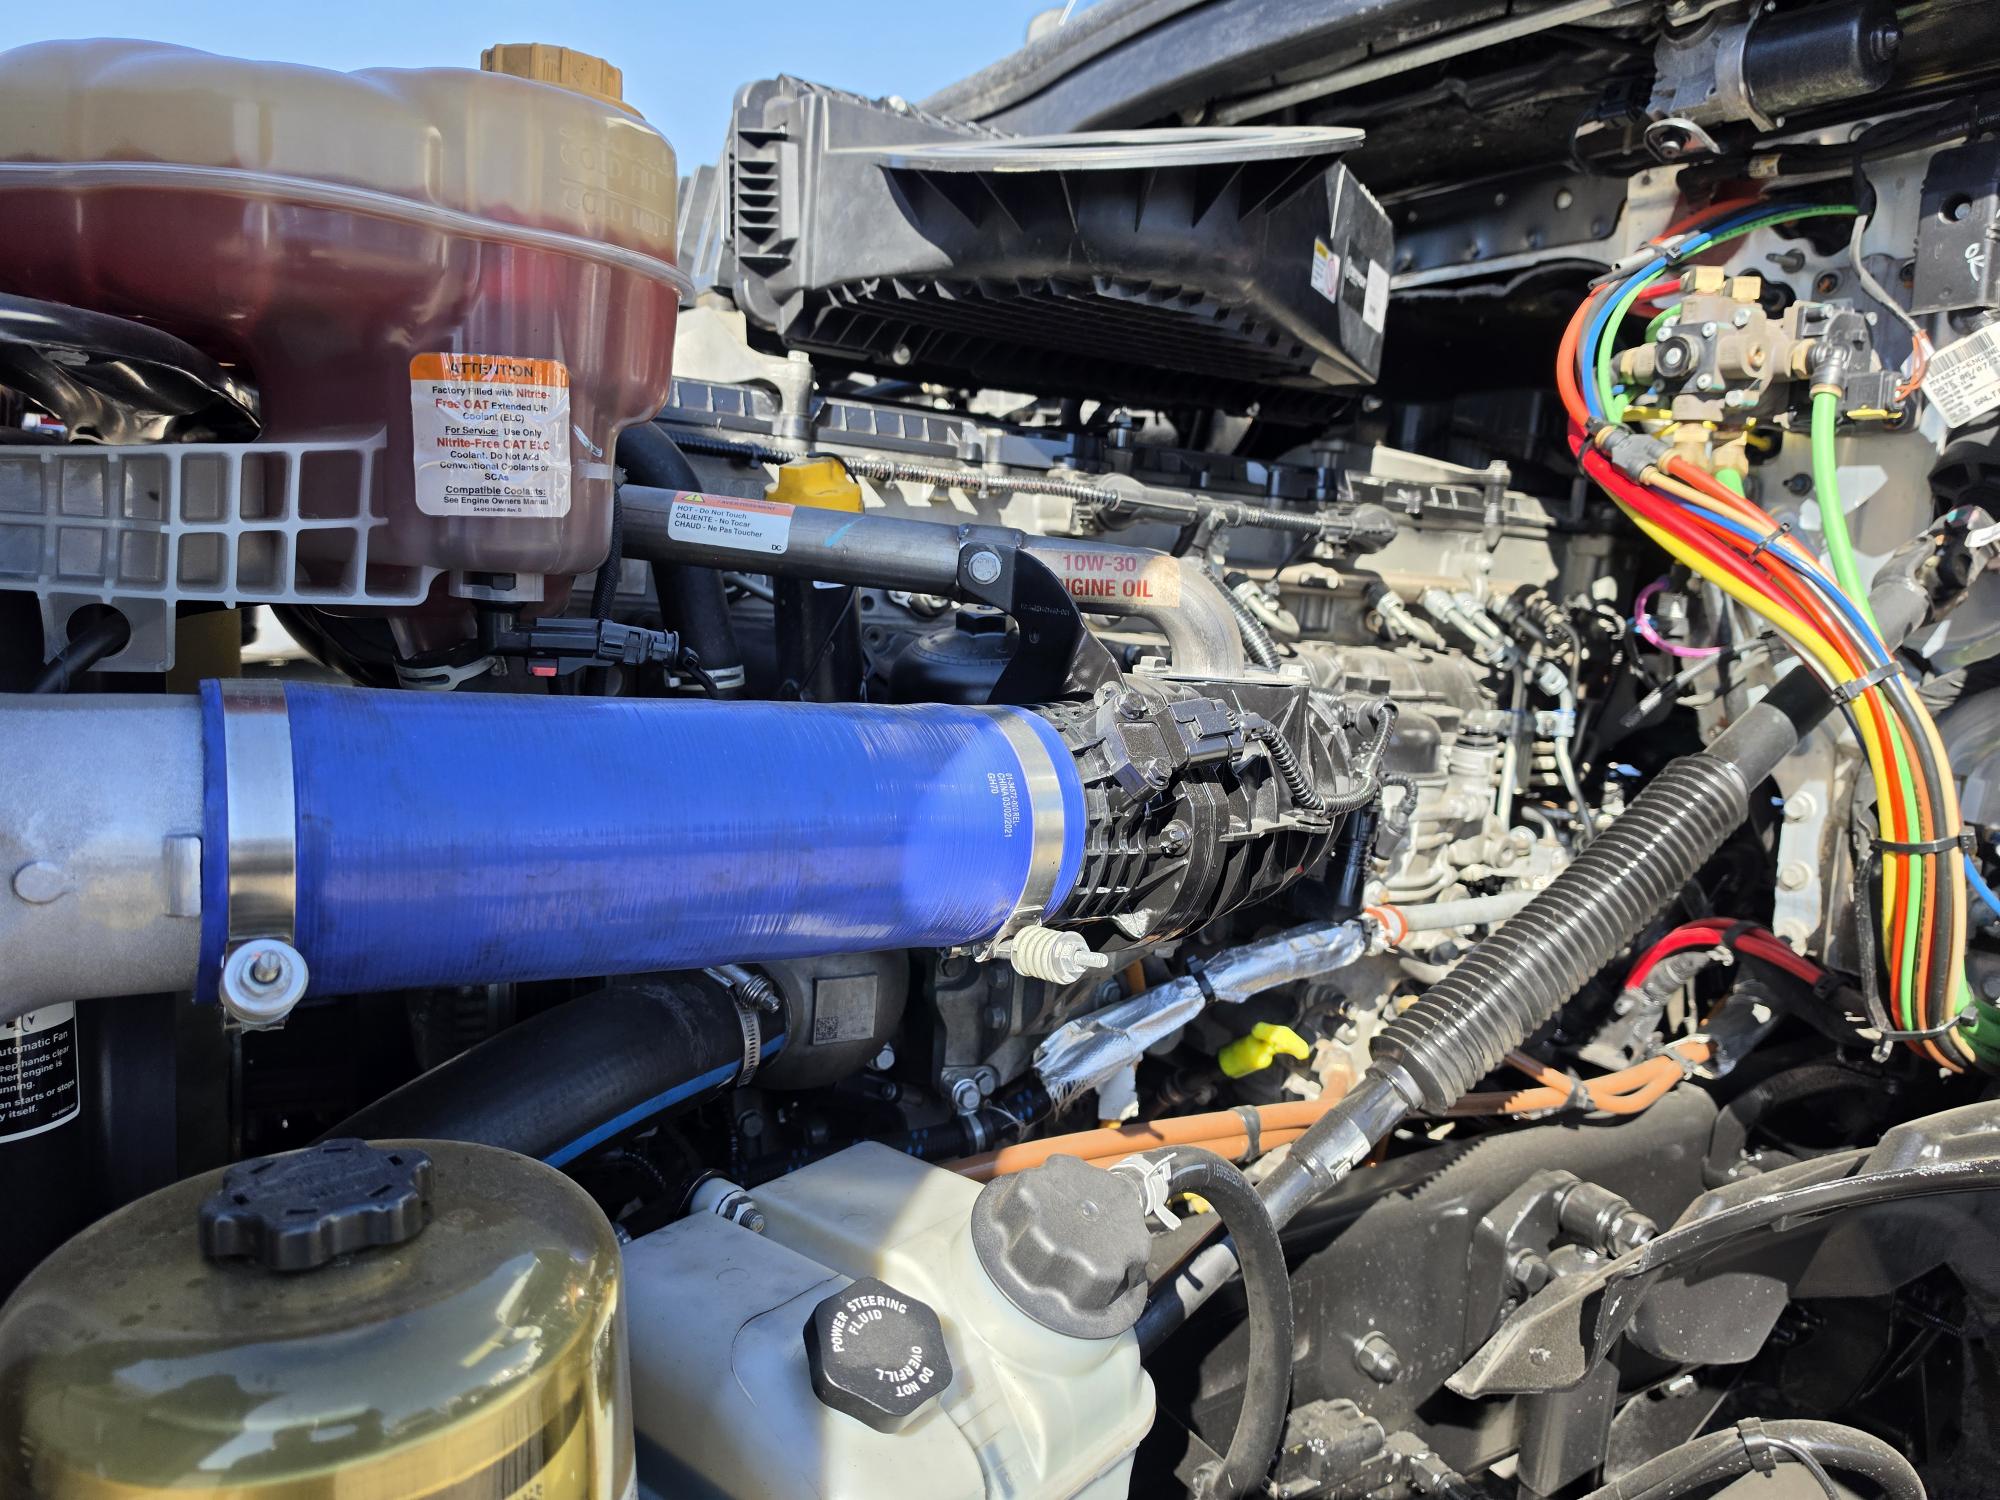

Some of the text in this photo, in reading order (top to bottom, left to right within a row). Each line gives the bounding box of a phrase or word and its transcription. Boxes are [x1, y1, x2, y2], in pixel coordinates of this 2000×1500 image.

[451, 362, 534, 378] ATTENTION
[432, 385, 466, 396] Factory
[468, 387, 493, 396] Filled
[495, 389, 514, 397] with
[435, 398, 460, 409] Free
[463, 399, 490, 410] OAT
[491, 401, 532, 412] Extended
[462, 412, 525, 424] Coolant (ELC)
[445, 425, 542, 439] For Service: Use Only
[436, 437, 551, 451] Nitrite-Free OAT ELC
[490, 452, 503, 460] Do
[505, 452, 521, 461] Not
[523, 452, 540, 461] Add
[440, 461, 499, 471] Conventional
[501, 462, 539, 472] Coolants
[484, 473, 510, 481] SCAs
[445, 485, 546, 497] Compatible Coolats:
[443, 496, 459, 504] See
[461, 496, 490, 506] Engine
[491, 497, 521, 505] Owners
[675, 512, 713, 523] CALIENTE
[731, 520, 751, 528] Tocar
[677, 504, 694, 512] HOT
[699, 507, 710, 515] Do
[726, 511, 748, 520] Touch
[674, 520, 702, 530] CHAUD
[707, 524, 718, 532] Ne
[734, 528, 763, 538] Toucher
[1063, 554, 1137, 572] 10W-30
[1059, 577, 1153, 598] NGINE OIL
[0, 1030, 69, 1057] utomatic Fan
[0, 1045, 70, 1073] eep hands clear
[0, 1060, 63, 1083] hen engine is
[0, 1081, 36, 1094] unning.
[0, 1079, 75, 1110] an starts or stops
[9, 1104, 39, 1119] itself.
[830, 1295, 907, 1353] POWER STEERING
[848, 1309, 883, 1336] FLUID
[875, 1345, 923, 1383] OVERFILL
[895, 1366, 935, 1397] DO NOT
